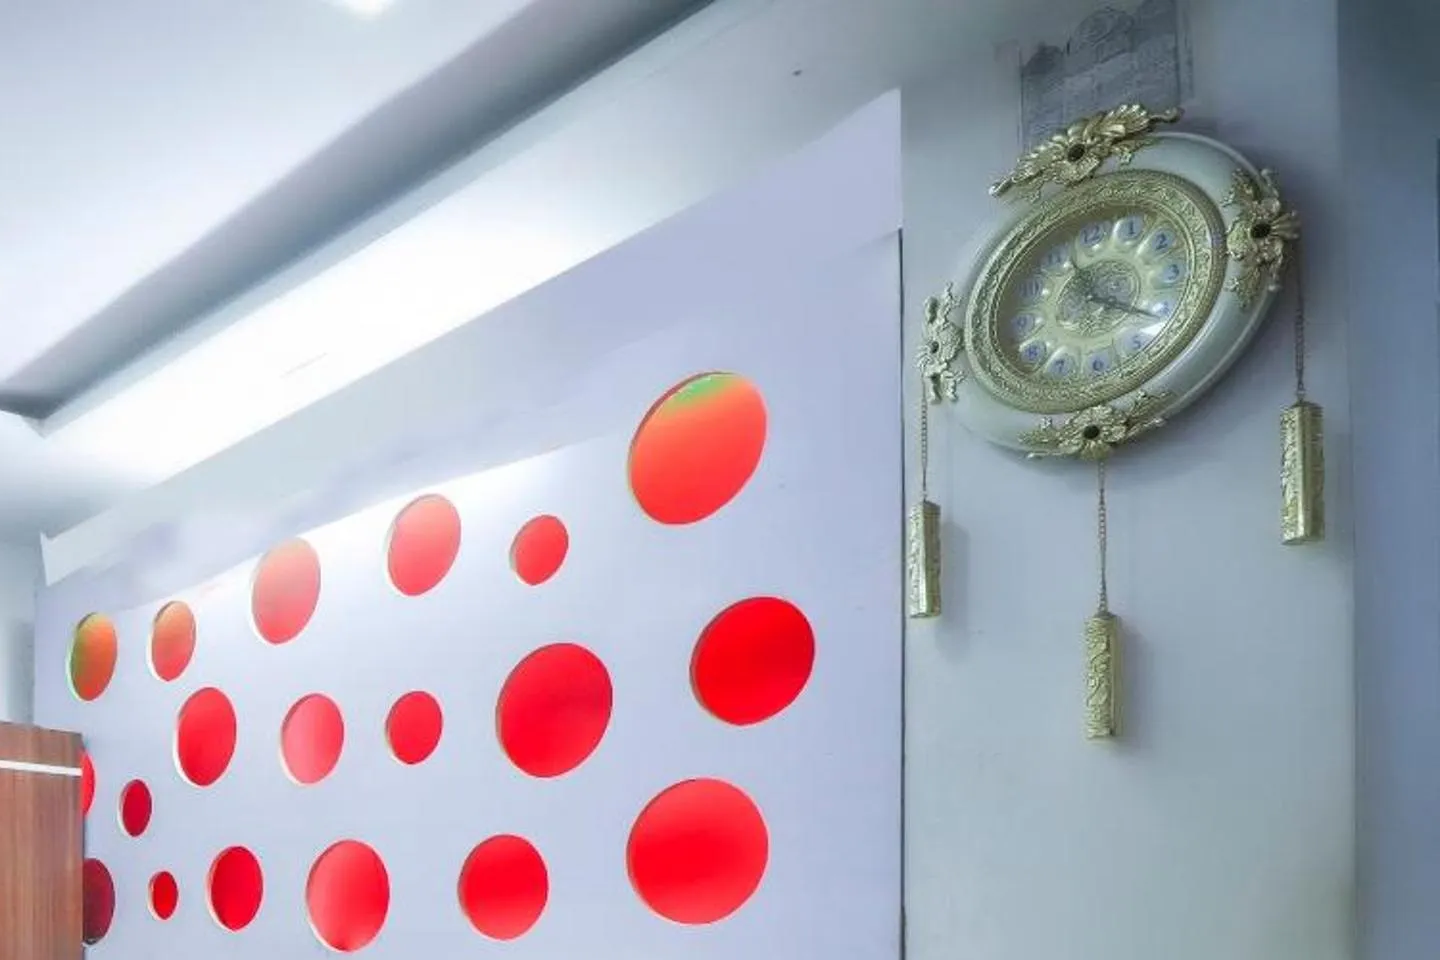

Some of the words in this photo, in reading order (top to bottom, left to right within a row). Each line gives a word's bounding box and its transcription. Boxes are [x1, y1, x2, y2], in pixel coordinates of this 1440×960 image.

[1082, 225, 1101, 244] 12
[1127, 220, 1135, 236] 1
[1156, 233, 1168, 250] 2
[1167, 263, 1180, 281] 3
[1132, 335, 1142, 350] 5
[1055, 359, 1066, 374] 7
[1092, 359, 1104, 372] 6
